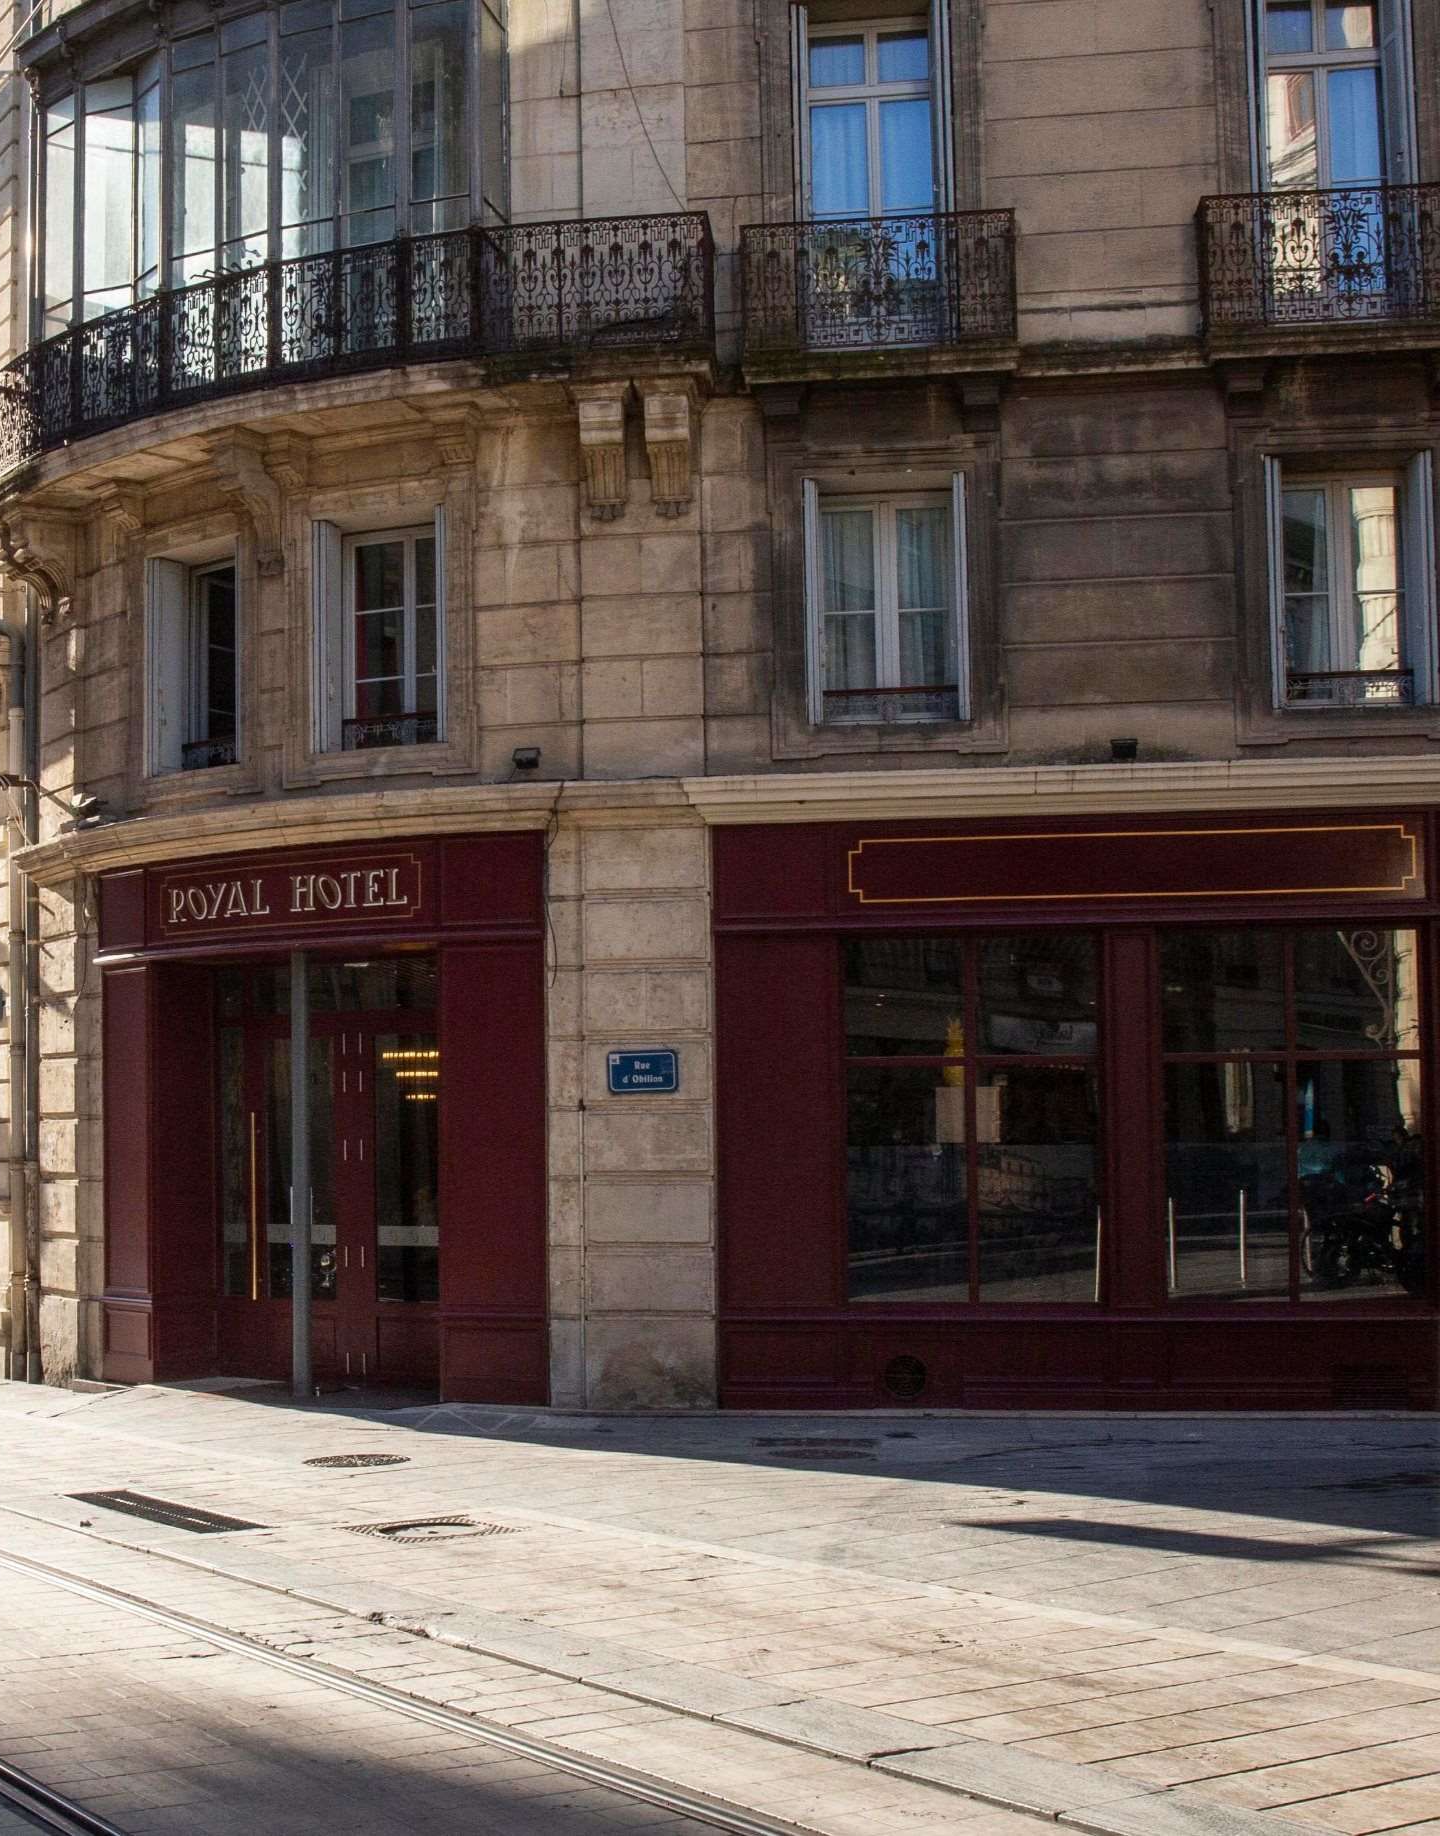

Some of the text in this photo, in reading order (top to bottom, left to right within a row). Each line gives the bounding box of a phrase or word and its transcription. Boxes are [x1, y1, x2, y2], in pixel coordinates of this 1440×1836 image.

[167, 867, 408, 923] ROYAL HOTEL
[634, 1060, 651, 1070] Rue
